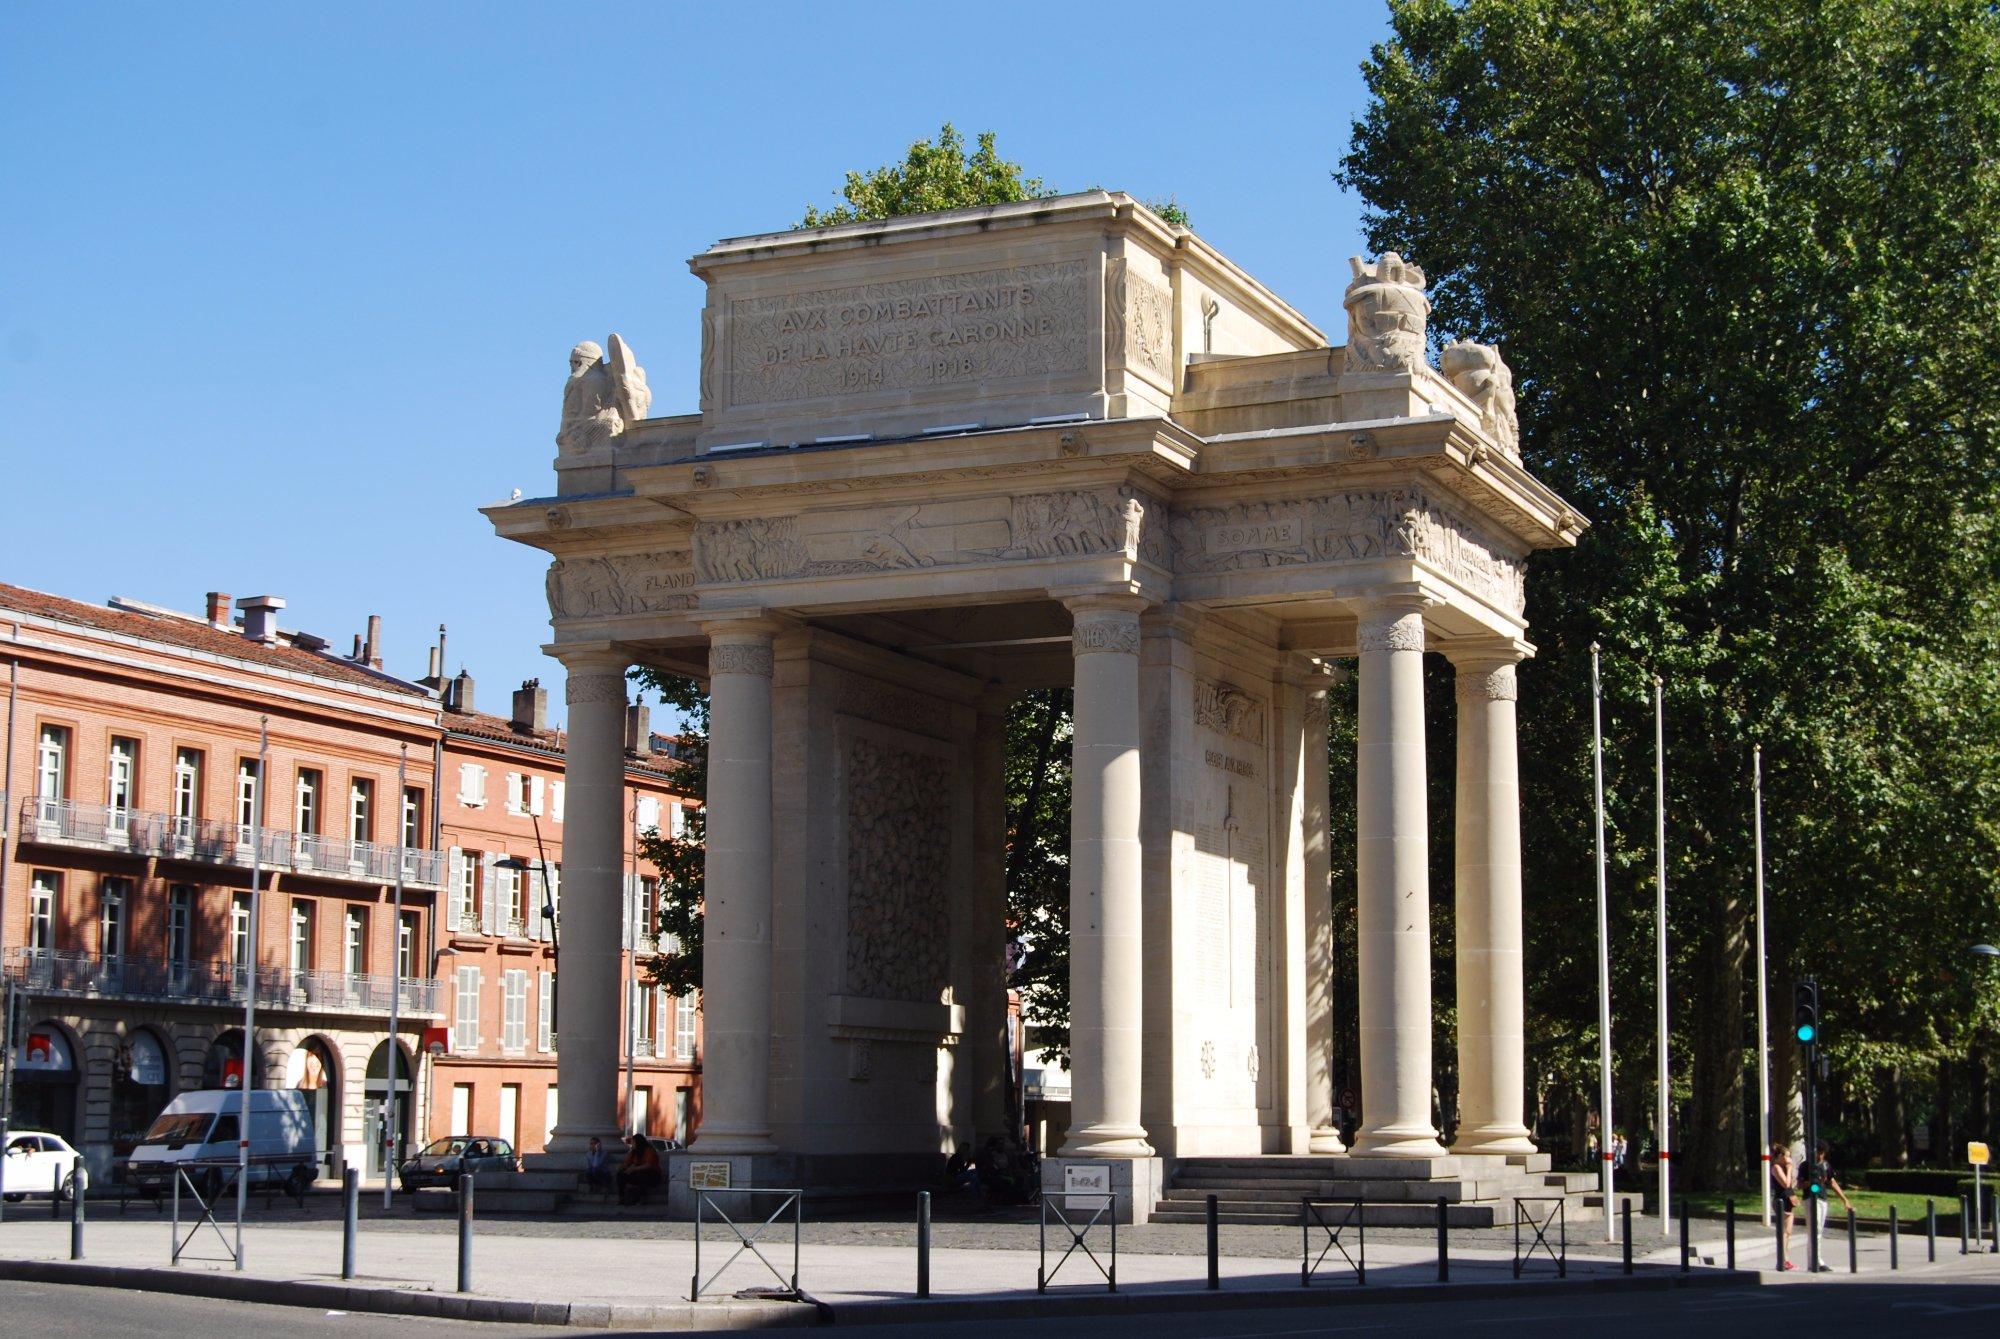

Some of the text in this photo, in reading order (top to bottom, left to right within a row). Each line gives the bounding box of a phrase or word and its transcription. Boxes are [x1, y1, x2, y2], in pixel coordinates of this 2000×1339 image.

[840, 286, 1034, 325] COMBATTANTS
[765, 344, 791, 365] DE
[800, 339, 829, 361] LA
[838, 359, 973, 386] 1914 1918
[1218, 525, 1291, 546] SOMME
